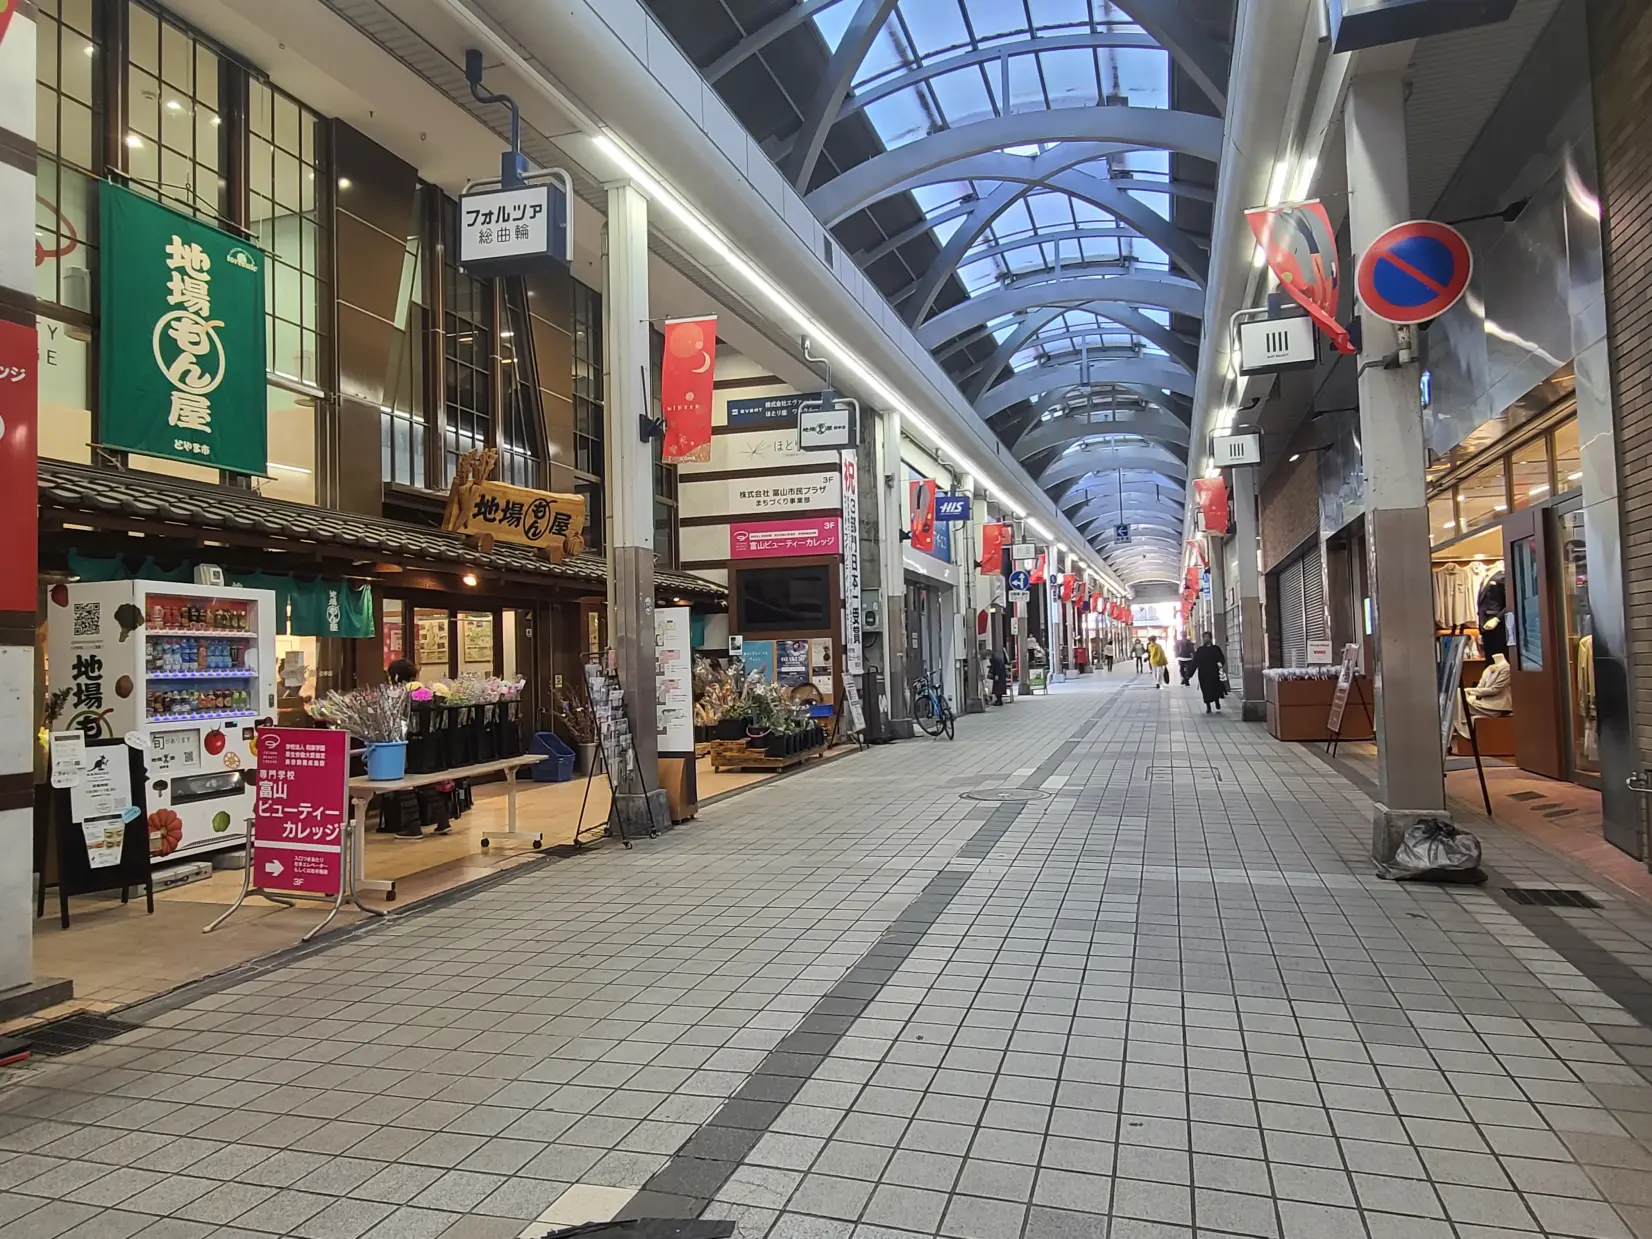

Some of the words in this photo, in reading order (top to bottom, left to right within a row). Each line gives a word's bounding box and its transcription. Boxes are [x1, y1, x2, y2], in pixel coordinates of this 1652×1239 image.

[466, 204, 543, 227] フォルツァ
[478, 224, 529, 244] 総曲輪
[153, 235, 224, 433] 地場もん屋
[174, 439, 210, 456] とやま市
[844, 460, 856, 495] 祝
[739, 490, 770, 499] 株式会社
[772, 486, 827, 497] 富山市民プラザ
[755, 497, 811, 507] まちづくり事業部
[939, 502, 964, 512] HIS
[472, 494, 572, 541] 地場もん屋
[824, 522, 835, 530] 3F
[749, 537, 835, 551] 富山ビューティーカレッジ
[260, 769, 295, 780] 専門学校
[259, 781, 287, 799] 富山
[259, 800, 340, 820] ビューティー
[282, 821, 340, 840] カレッジ
[293, 878, 304, 886] 3F
